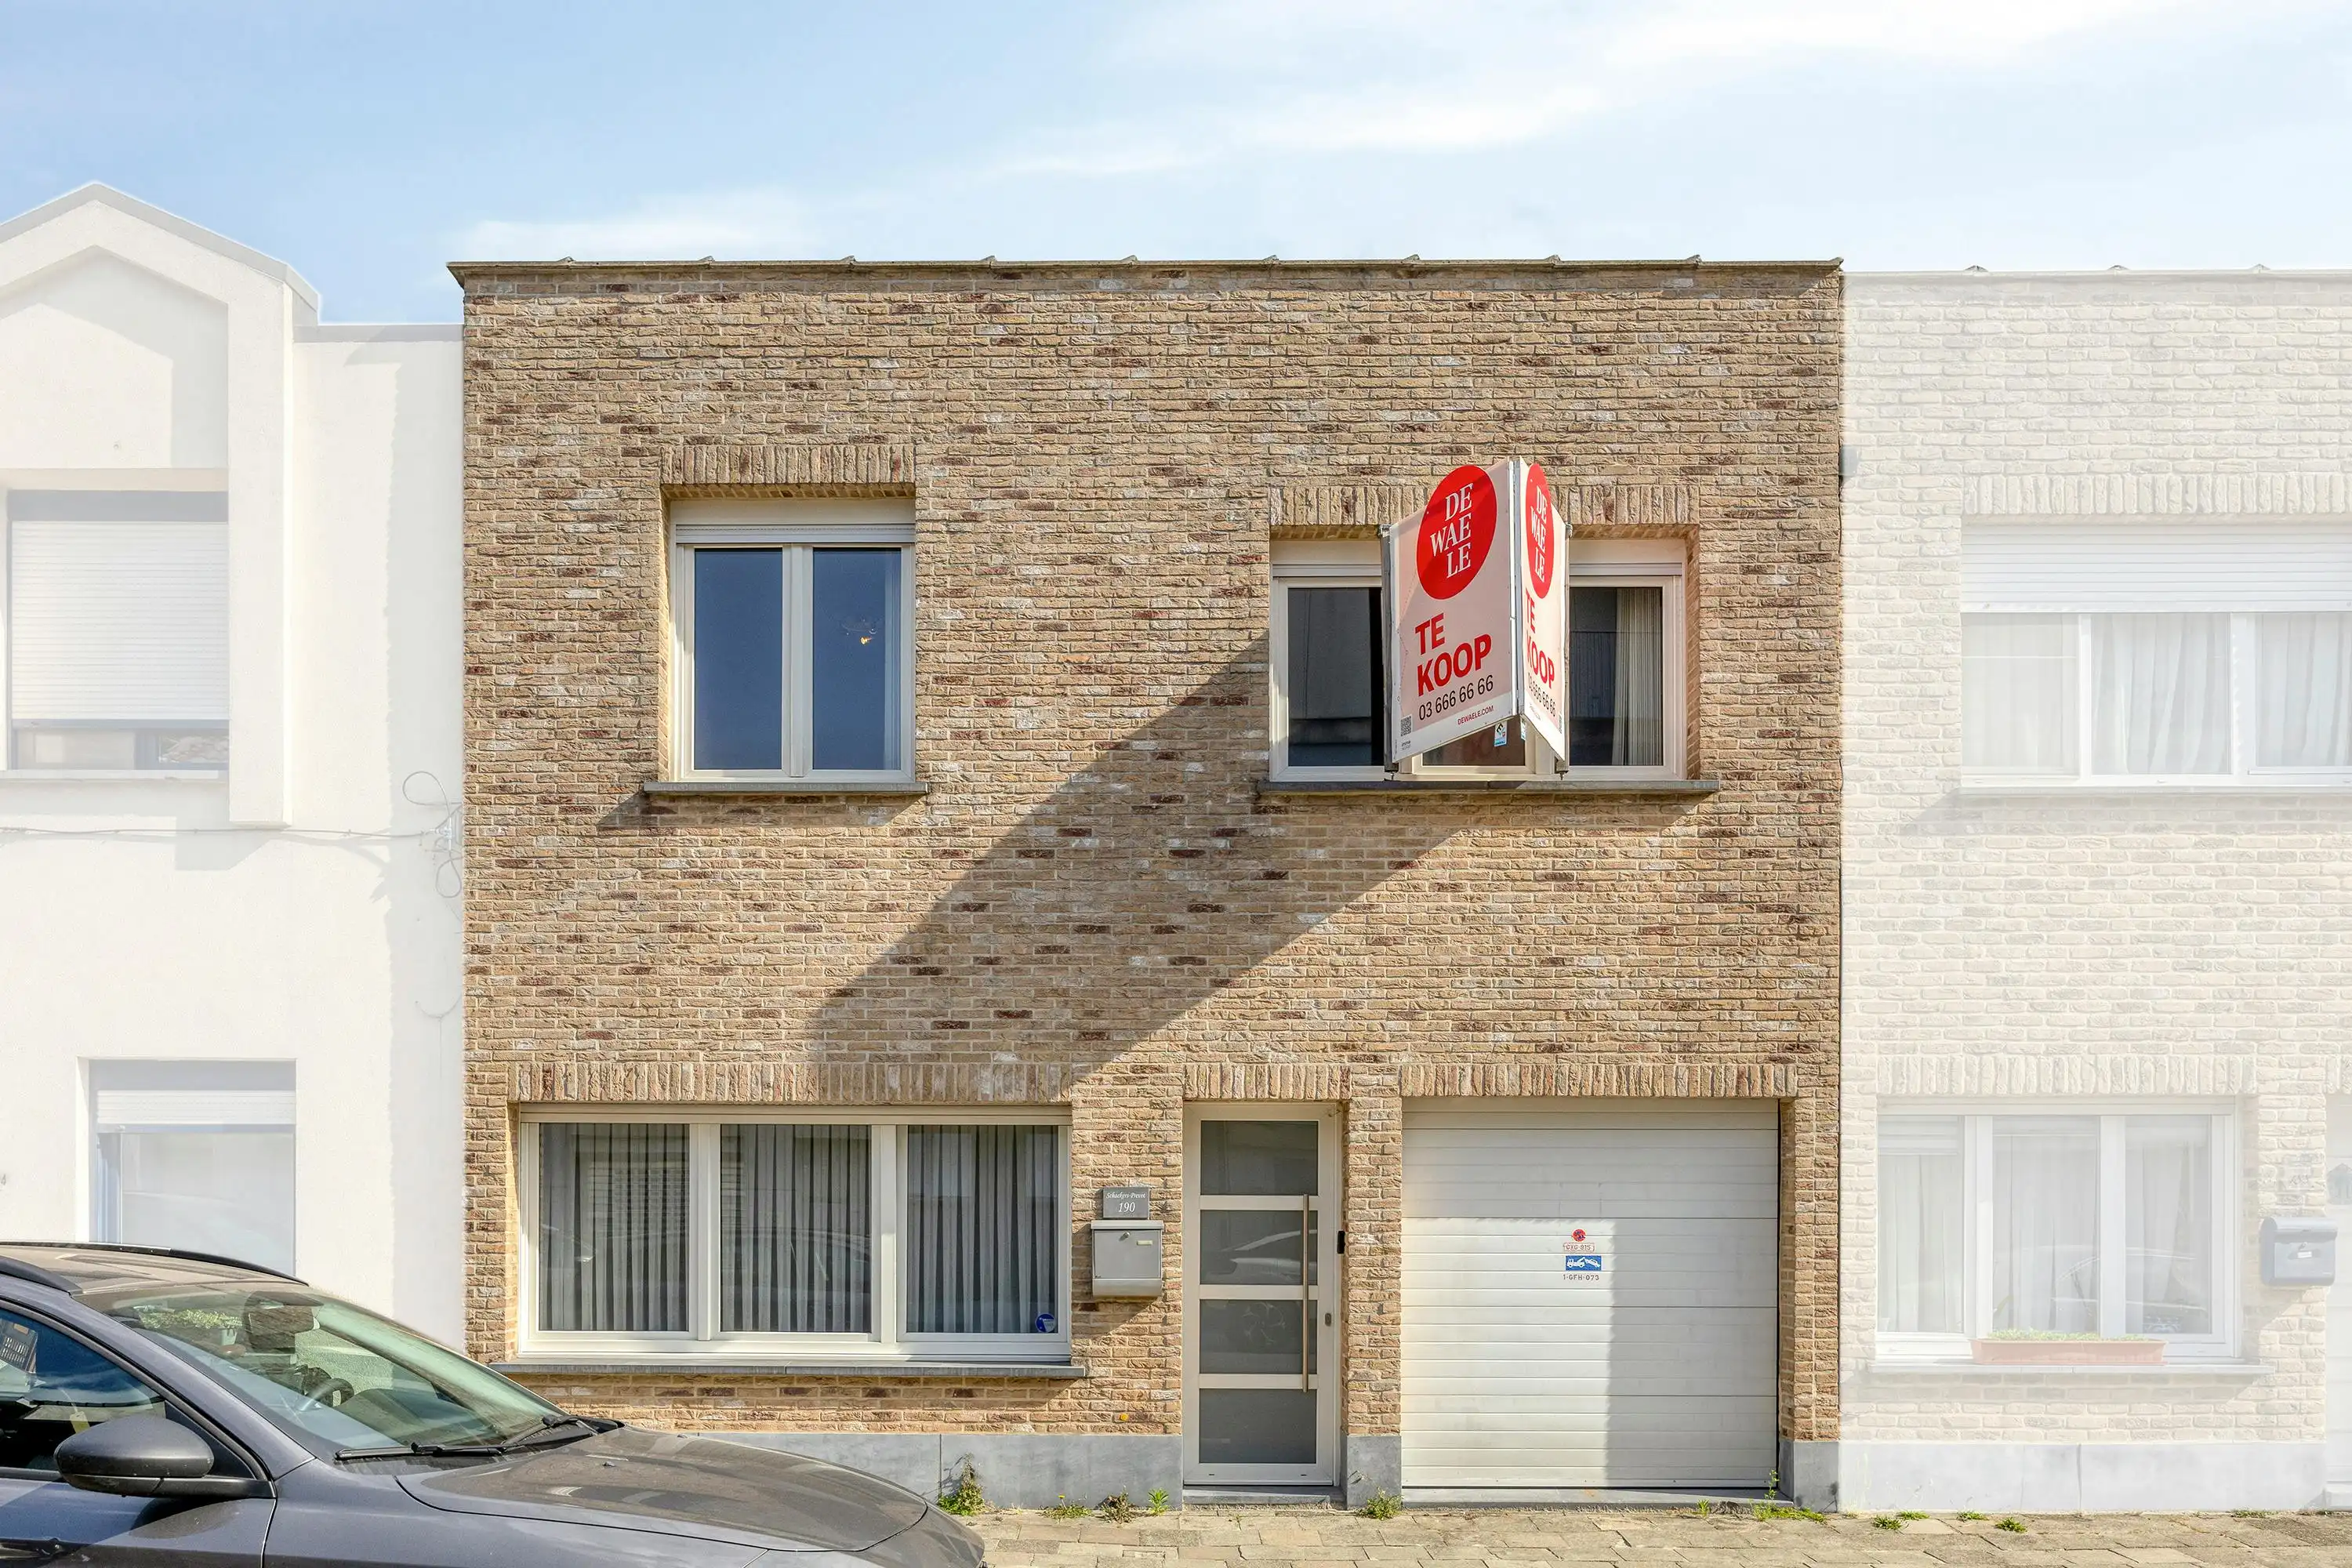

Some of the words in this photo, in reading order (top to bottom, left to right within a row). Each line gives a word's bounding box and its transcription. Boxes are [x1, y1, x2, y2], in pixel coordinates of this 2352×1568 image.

[1445, 482, 1474, 522] DE
[1537, 485, 1548, 524] DE
[1429, 513, 1472, 557] WAE
[1530, 505, 1546, 554] WAE
[1446, 542, 1471, 579] LE
[1535, 546, 1544, 583] LE
[1525, 586, 1536, 633] TE
[1415, 612, 1445, 655] TE
[1417, 633, 1492, 697] KOOP
[1526, 630, 1555, 689] KOOP
[1419, 701, 1432, 720] 03
[1435, 690, 1456, 713] 666
[1459, 682, 1474, 702] 66
[1477, 675, 1494, 695] 66
[1457, 705, 1494, 725] DEWAELE.COM
[1118, 1202, 1136, 1213] 190
